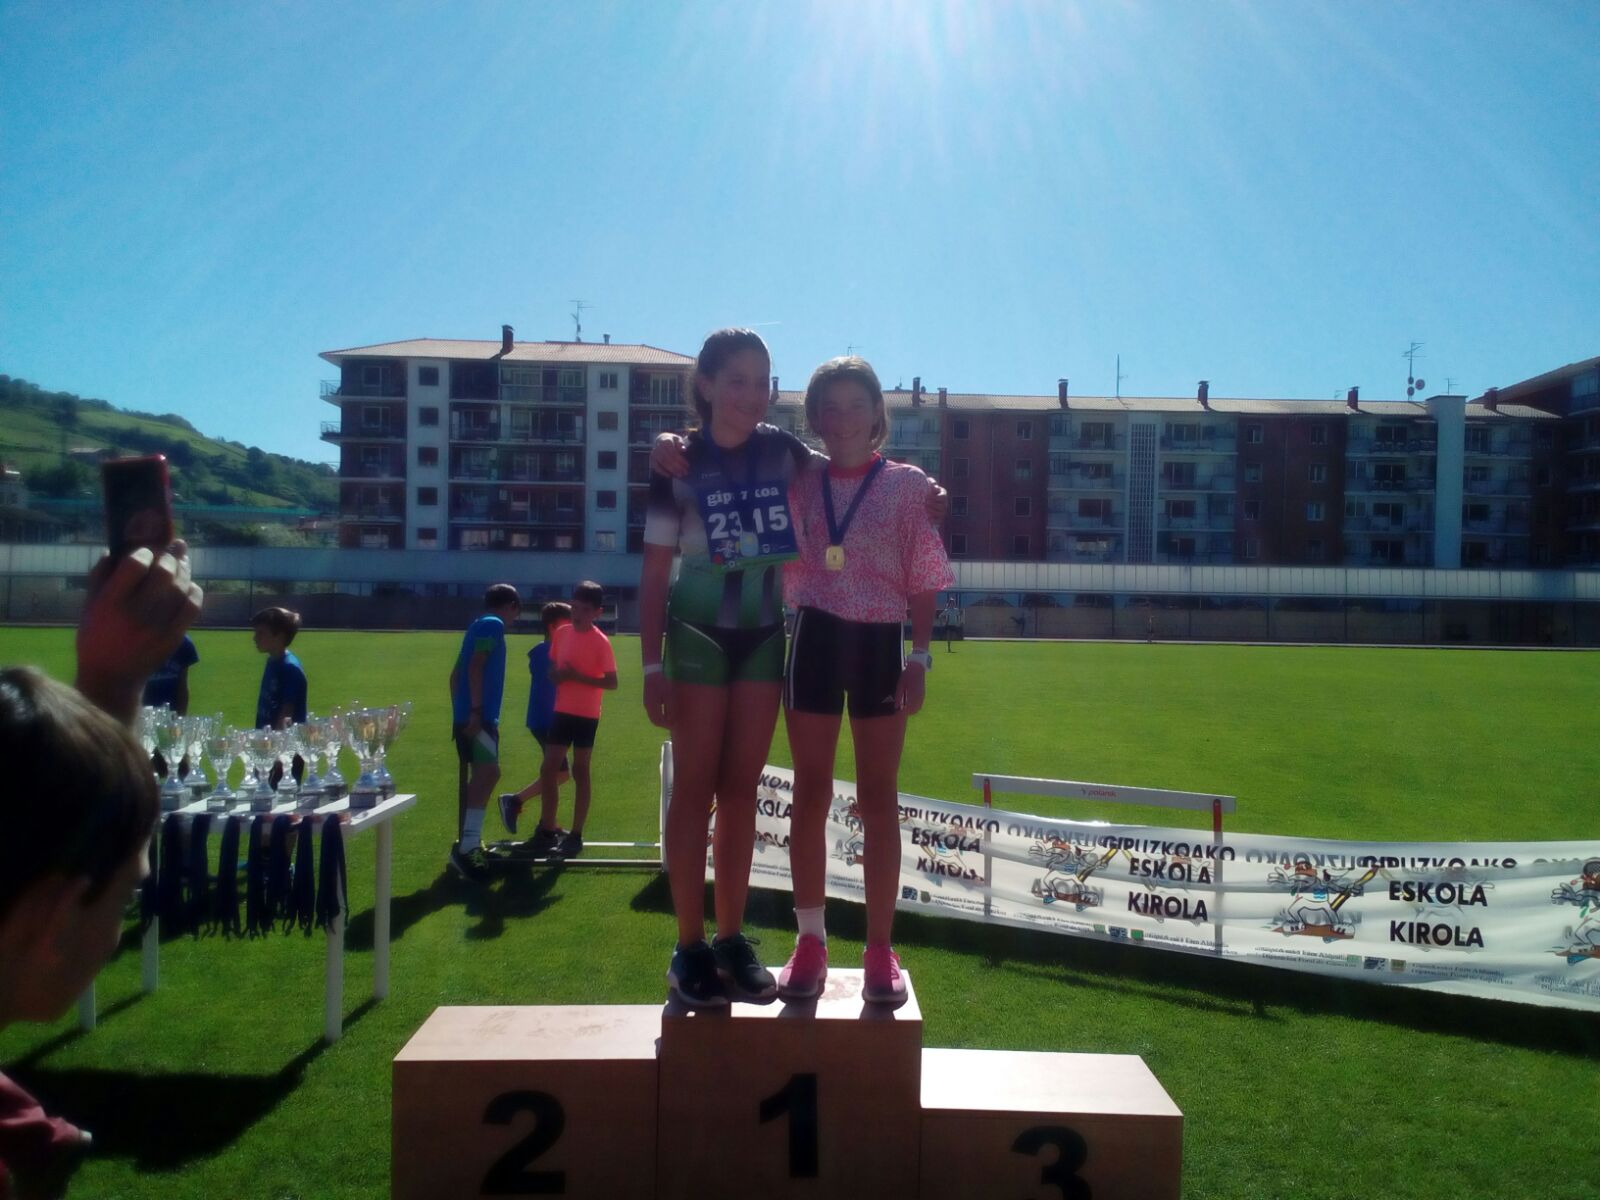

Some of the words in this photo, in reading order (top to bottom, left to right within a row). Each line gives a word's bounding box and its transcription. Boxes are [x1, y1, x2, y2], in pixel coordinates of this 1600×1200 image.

[912, 827, 980, 853] ESKOLA
[1129, 857, 1211, 884] ESKOLA
[1127, 891, 1208, 922] KIROLA
[1389, 880, 1488, 907] ESKOLA
[1390, 920, 1484, 948] KIROLA
[759, 1073, 818, 1178] 1
[480, 1090, 566, 1195] 2
[1009, 1125, 1094, 1200] 3
